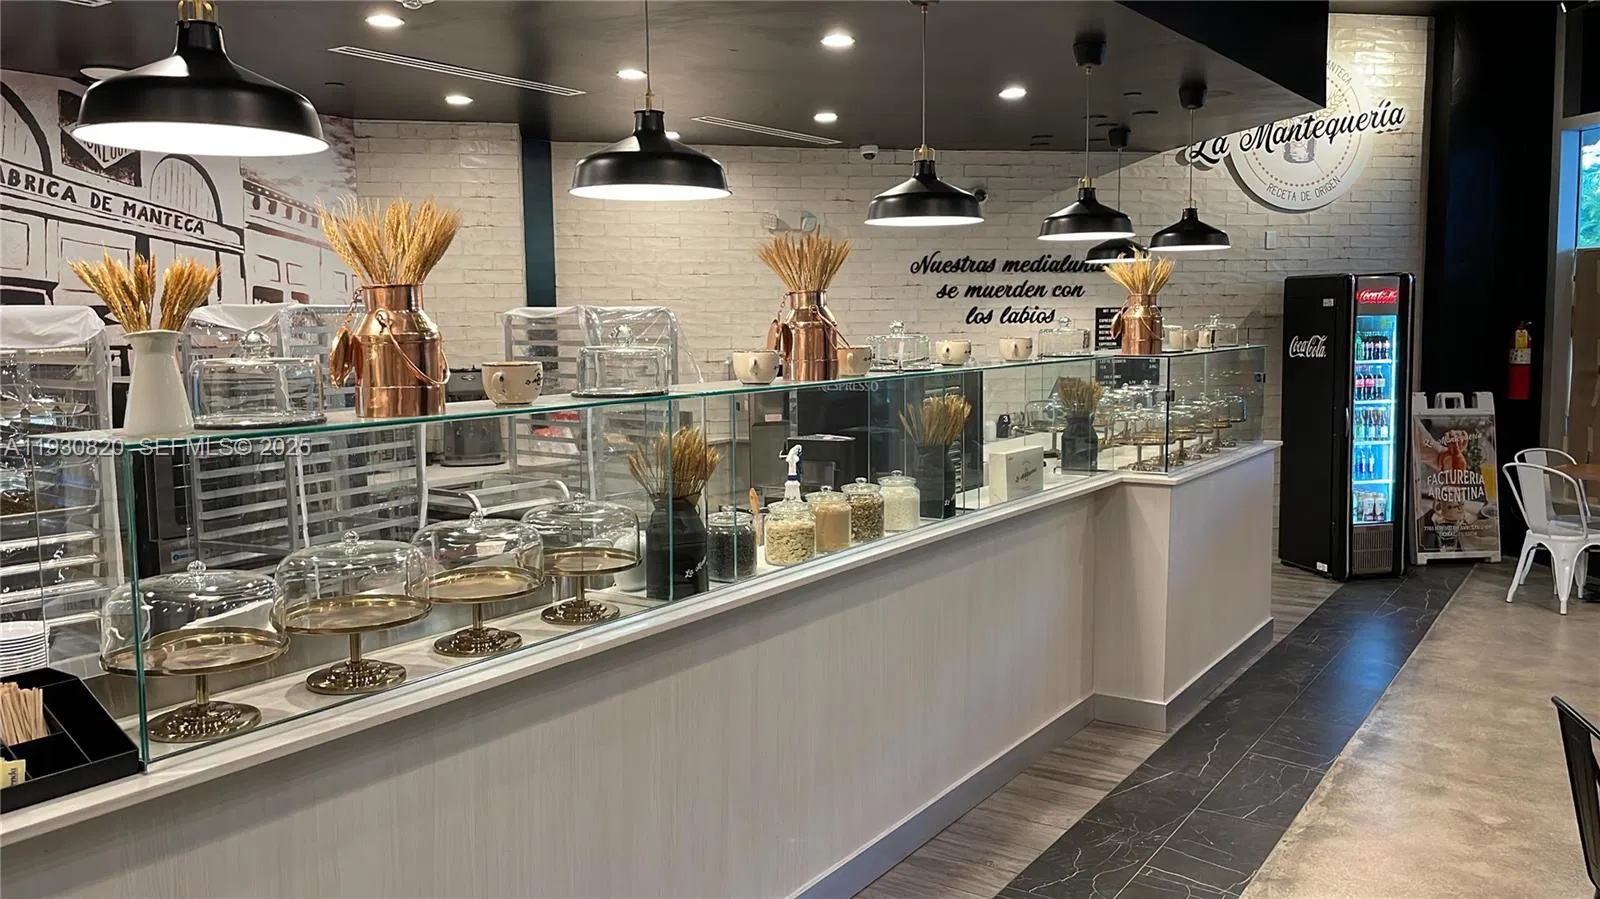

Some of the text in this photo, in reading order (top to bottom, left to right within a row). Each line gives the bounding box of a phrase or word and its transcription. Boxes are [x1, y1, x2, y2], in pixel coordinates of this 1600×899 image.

[1188, 99, 1406, 164] La Mantequería
[1266, 175, 1342, 202] RECETA DE ORIGEN
[90, 191, 113, 213] DE
[123, 201, 205, 235] MANTECA
[910, 250, 997, 275] Nuestras
[936, 280, 1086, 299] se muerden con
[965, 305, 1057, 324] los labios
[1427, 469, 1485, 485] FACTURERIA
[1428, 486, 1485, 502] ARGENTINA
